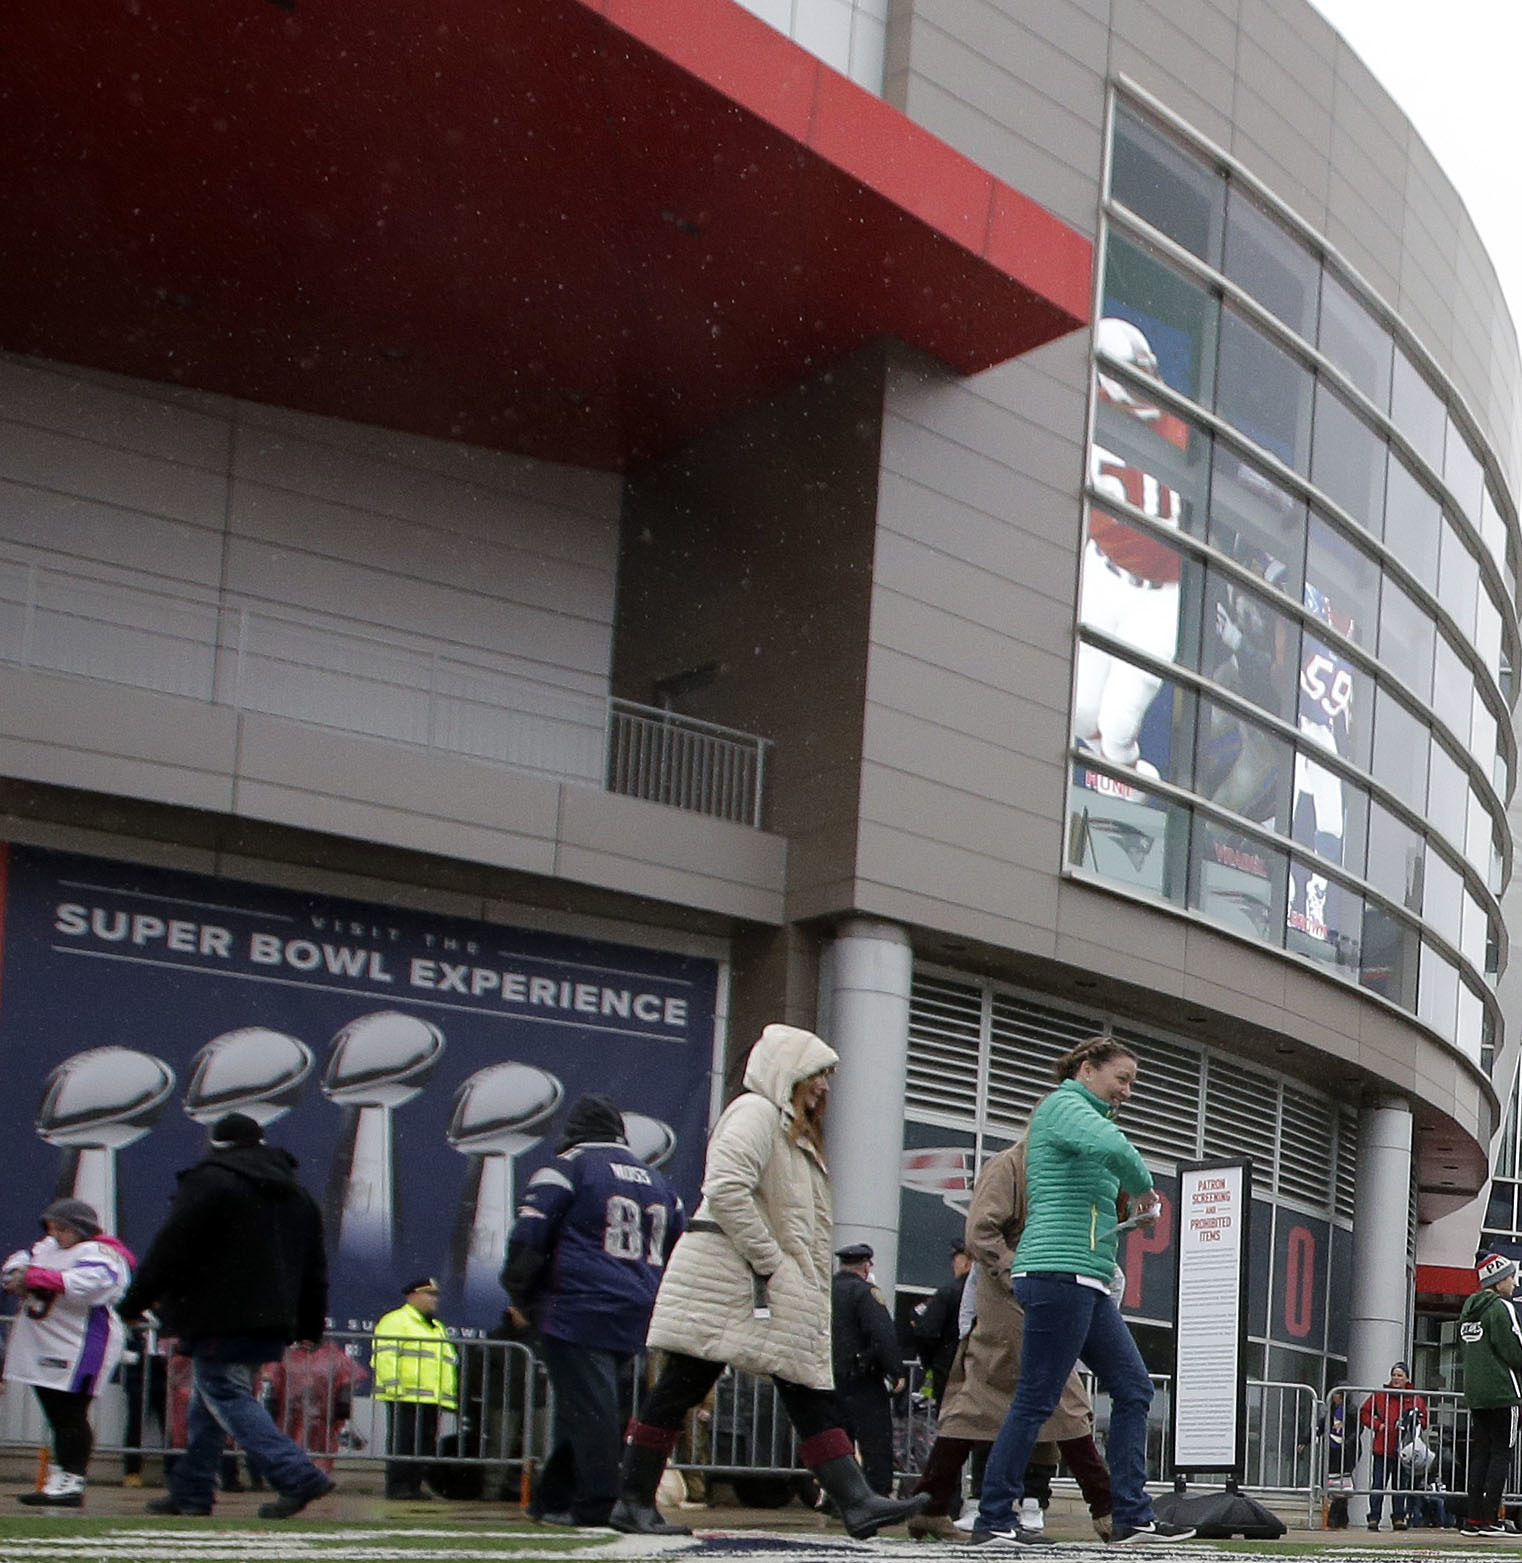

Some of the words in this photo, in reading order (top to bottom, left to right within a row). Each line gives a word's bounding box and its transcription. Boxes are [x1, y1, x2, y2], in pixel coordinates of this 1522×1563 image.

[1300, 654, 1352, 716] 59
[311, 914, 399, 940] VISIT
[425, 933, 480, 954] THE
[54, 902, 233, 959] SUPER
[249, 932, 394, 984] BOWL
[409, 956, 690, 1027] EXPERIENCE
[1192, 1191, 1231, 1205] SCREENING
[1198, 1179, 1225, 1191] PATRON
[603, 1195, 668, 1267] 81
[1190, 1216, 1231, 1230] PROHIBITED
[1199, 1231, 1221, 1242] ITEMS
